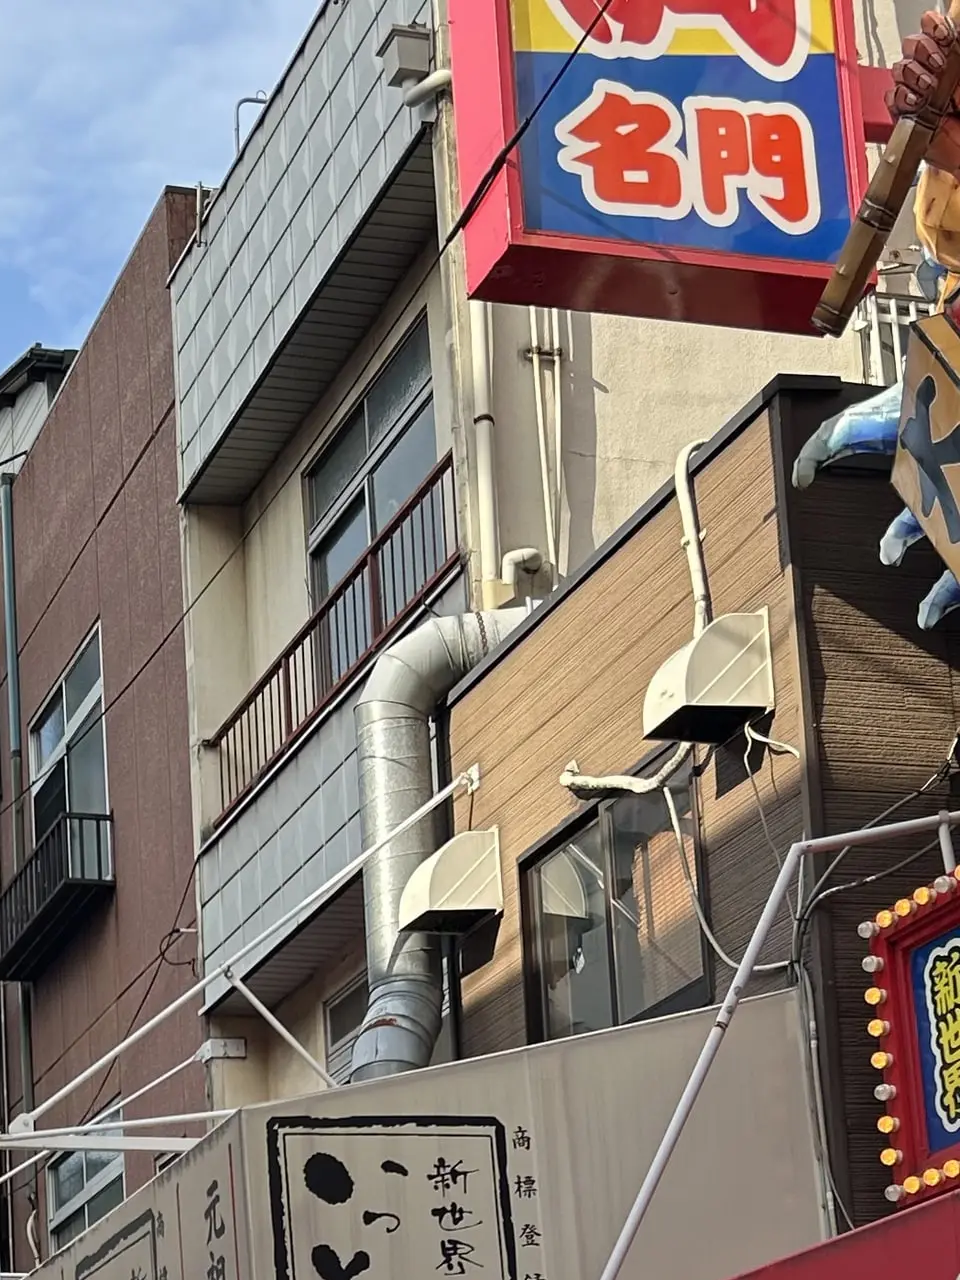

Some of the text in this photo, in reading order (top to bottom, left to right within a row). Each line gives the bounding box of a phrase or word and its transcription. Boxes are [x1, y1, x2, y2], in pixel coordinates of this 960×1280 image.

[558, 82, 818, 232] 名門
[427, 1156, 485, 1277] 新世界
